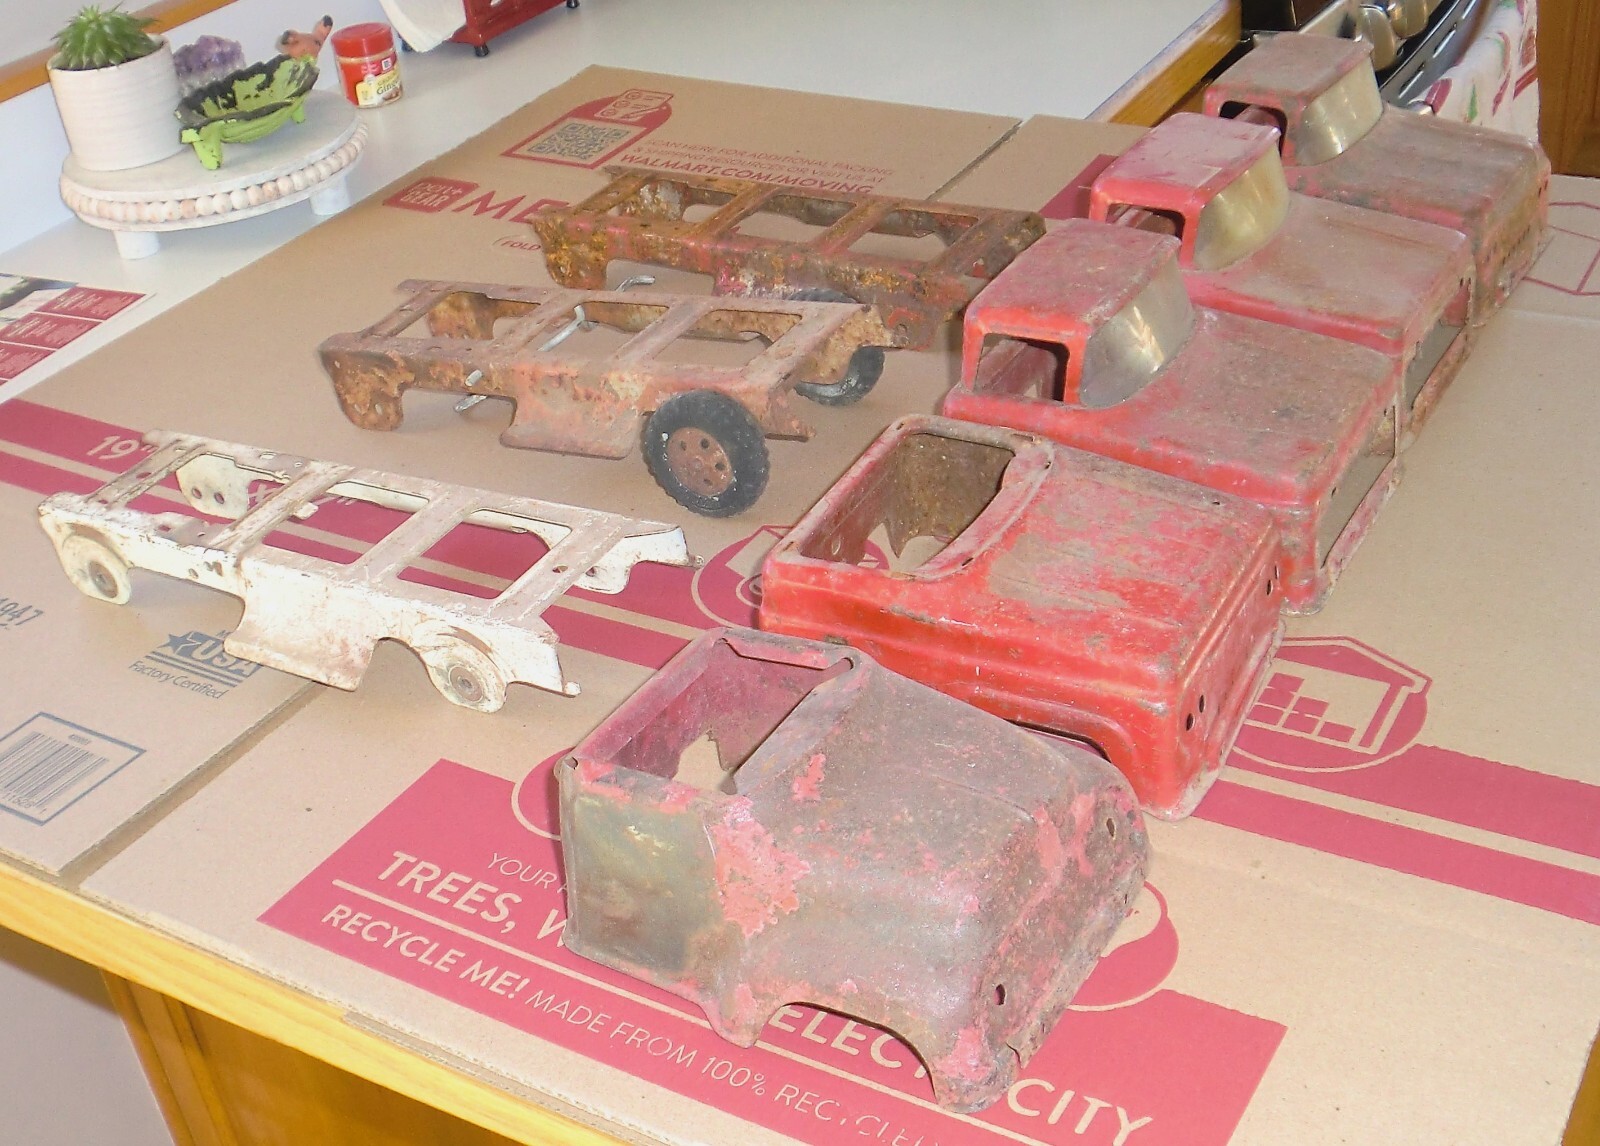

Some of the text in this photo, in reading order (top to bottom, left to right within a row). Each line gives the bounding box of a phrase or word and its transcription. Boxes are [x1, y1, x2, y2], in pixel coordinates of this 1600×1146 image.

[620, 154, 875, 194] WALMART.COM/MOVING
[717, 147, 748, 157] FOR
[747, 151, 829, 167] ADDITIONAL
[832, 161, 894, 176] PACKING
[787, 165, 810, 174] OR
[812, 168, 842, 178] VISIT
[0, 598, 44, 626] 947
[128, 660, 230, 700] Factory Certified
[487, 852, 558, 888] YOUR
[377, 851, 523, 935] TREES,
[320, 903, 464, 974] RECYCLE
[460, 958, 532, 1000] ME!
[525, 989, 611, 1033] MADE
[609, 1021, 698, 1069] FROM
[701, 1054, 767, 1097] 100%
